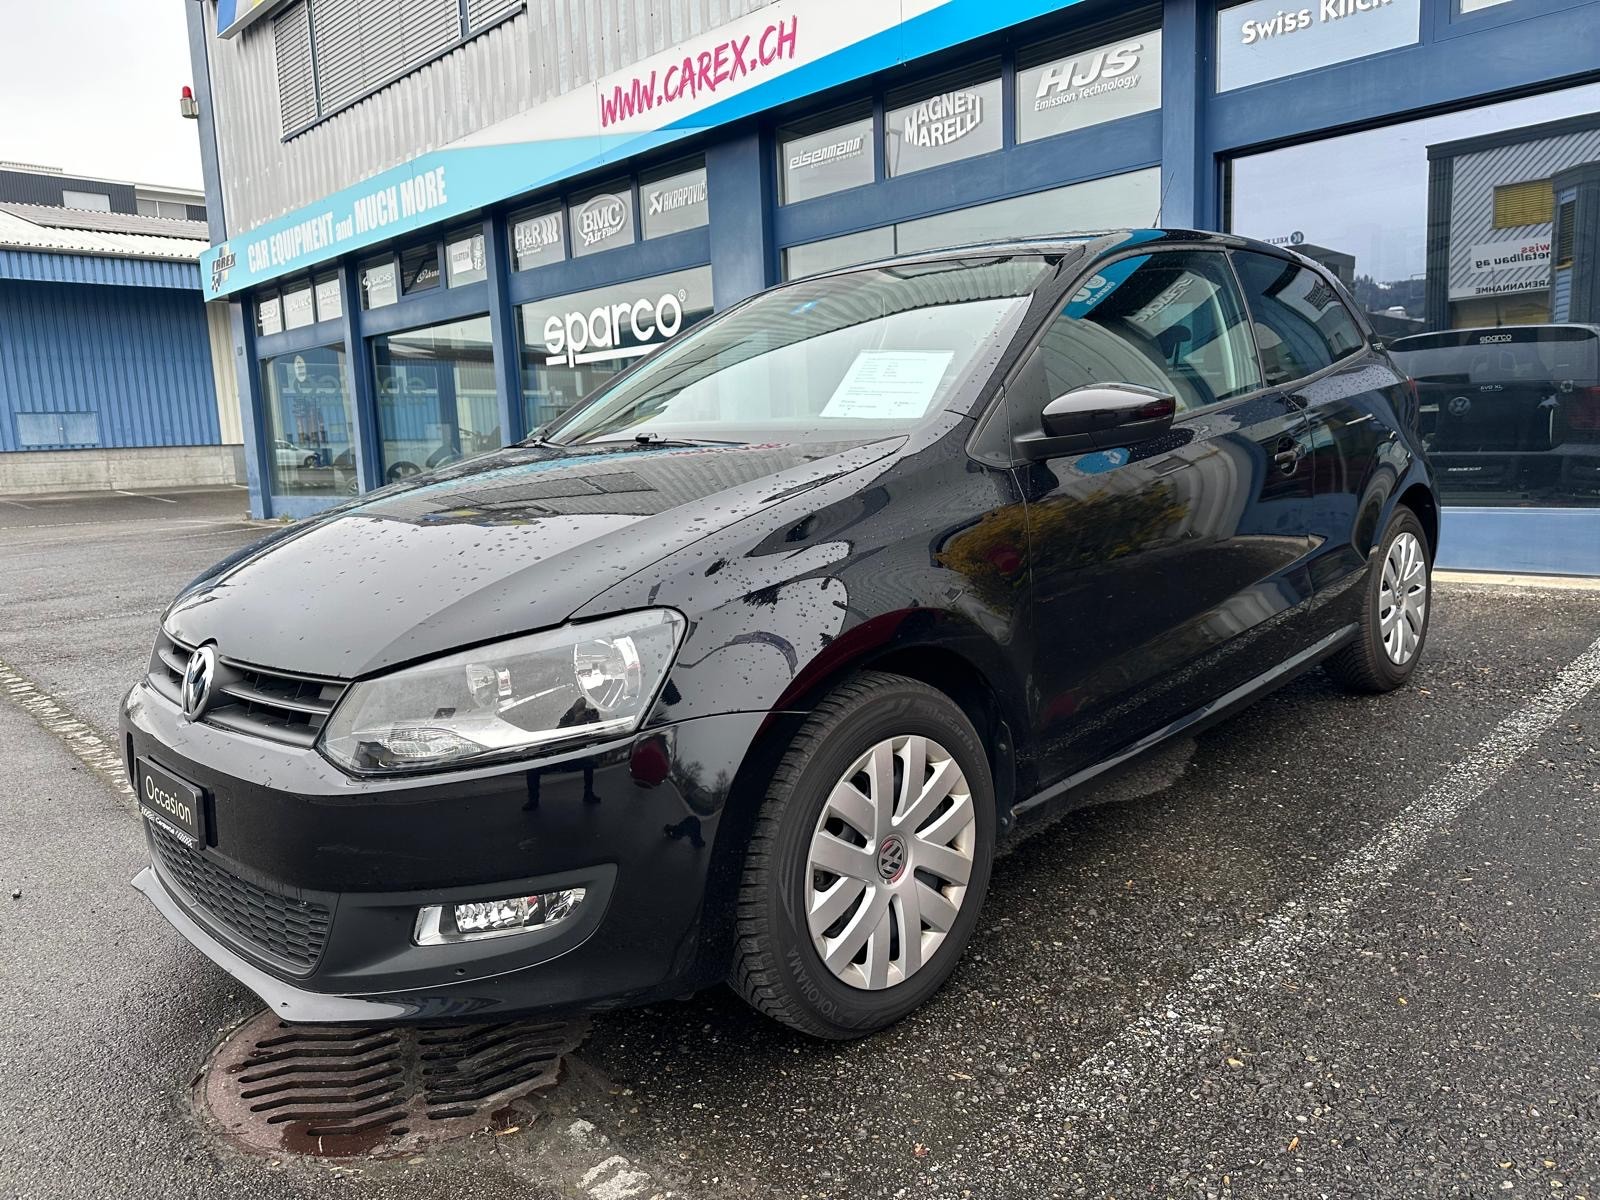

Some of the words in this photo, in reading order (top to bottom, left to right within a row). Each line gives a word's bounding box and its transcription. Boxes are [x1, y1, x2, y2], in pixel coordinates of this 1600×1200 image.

[1241, 8, 1312, 45] Swiss
[601, 15, 798, 128] WWW.CAREX.CH
[1035, 42, 1143, 99] HJS
[905, 92, 981, 135] MAGNETI
[1034, 91, 1077, 112] Emission
[1079, 73, 1140, 99] Technology
[905, 104, 981, 148] MARELLI
[789, 136, 862, 169] eisenmann
[247, 238, 271, 274] CAR
[271, 212, 334, 268] EQUIPMENT
[335, 214, 353, 242] and
[354, 187, 399, 235] MUCH
[400, 166, 448, 219] MORE
[514, 222, 542, 250] H&R
[582, 203, 620, 233] BMC
[584, 230, 602, 247] Air
[543, 293, 683, 368] sparco
[145, 775, 192, 826] Occasion
[786, 944, 838, 1021] YOKOHAMA
